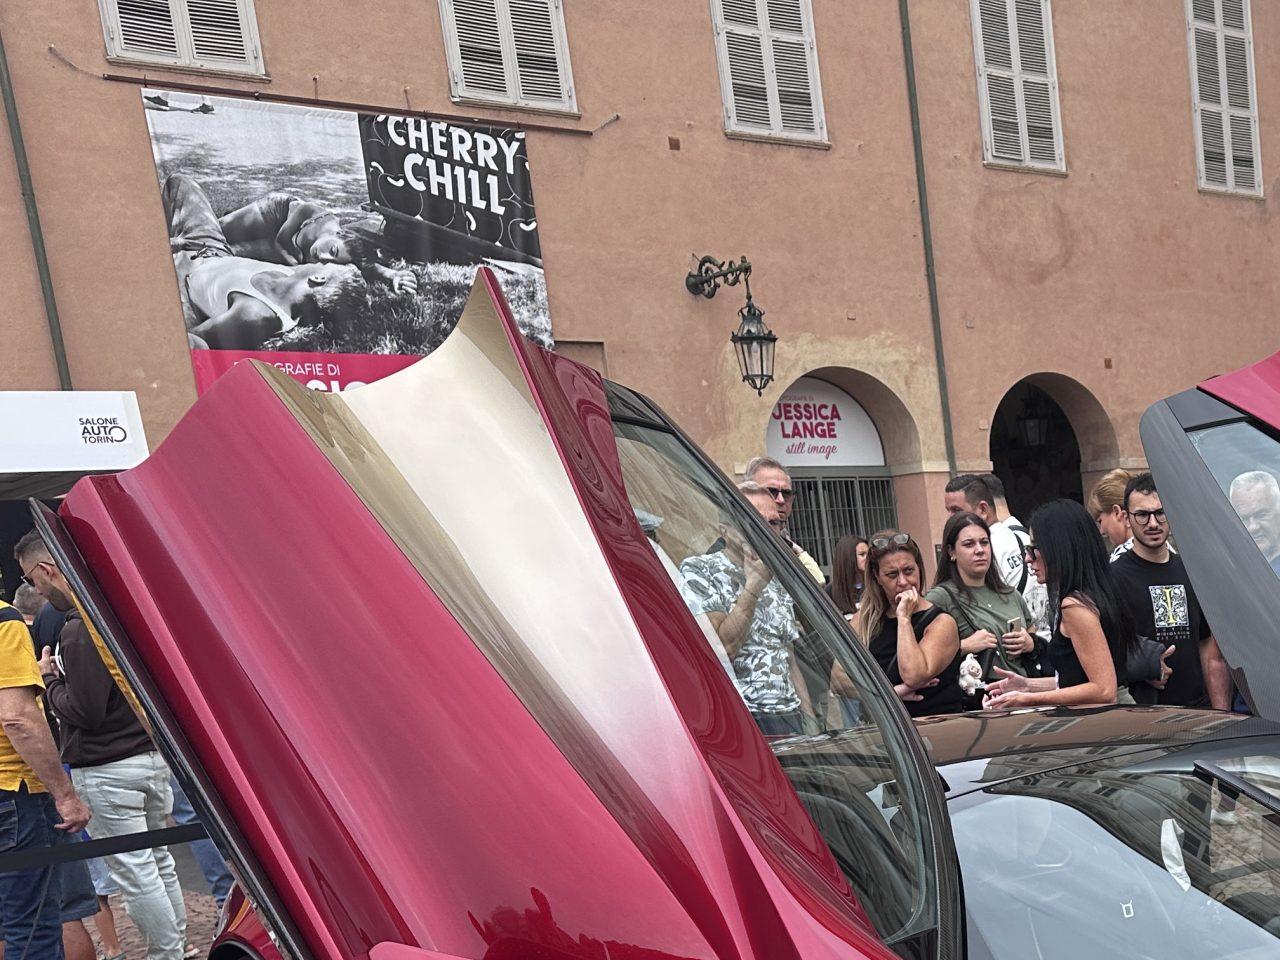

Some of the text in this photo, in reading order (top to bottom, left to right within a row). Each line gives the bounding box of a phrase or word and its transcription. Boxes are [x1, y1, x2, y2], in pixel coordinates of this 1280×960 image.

[387, 115, 520, 175] CHERRY
[403, 152, 506, 216] CHILL
[327, 363, 341, 377] DI
[772, 402, 842, 421] JESSICA
[78, 417, 119, 426] SALONE
[780, 421, 838, 439] LANGE
[81, 425, 127, 443] AUTO
[785, 441, 838, 461] still image
